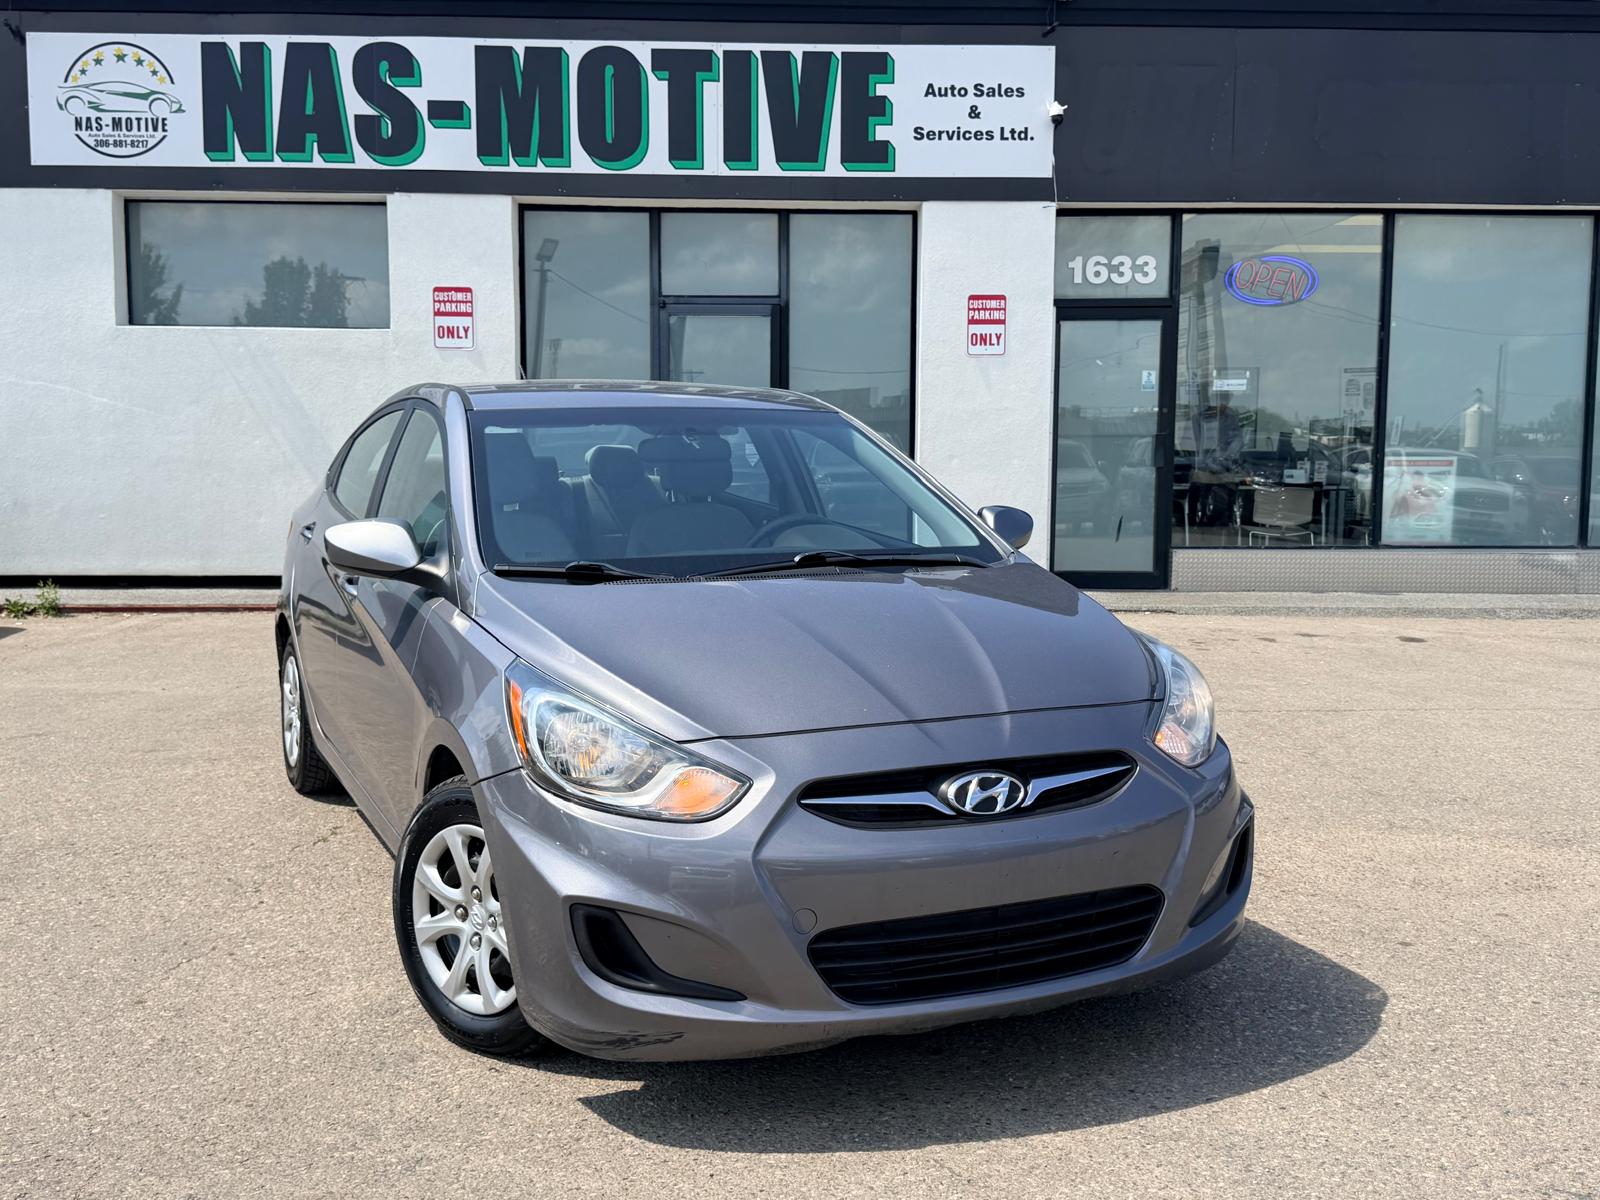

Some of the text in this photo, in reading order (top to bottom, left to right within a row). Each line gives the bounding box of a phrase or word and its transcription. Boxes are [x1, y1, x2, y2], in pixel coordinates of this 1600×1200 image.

[924, 83, 1025, 98] Auto Sales
[201, 42, 895, 172] NAS-MOTIVE
[968, 105, 981, 119] &
[75, 116, 168, 132] NAS-MOTIVE
[913, 126, 1035, 141] Services Ltd.
[1068, 255, 1157, 285] 1633
[1236, 260, 1306, 301] OPEN
[434, 291, 472, 301] CUSTOMER
[435, 302, 472, 312] PARKING
[969, 300, 1005, 309] CUSTOMER
[969, 310, 1005, 320] PARKING
[437, 325, 470, 339] ONLY
[970, 332, 1002, 346] ONLY
